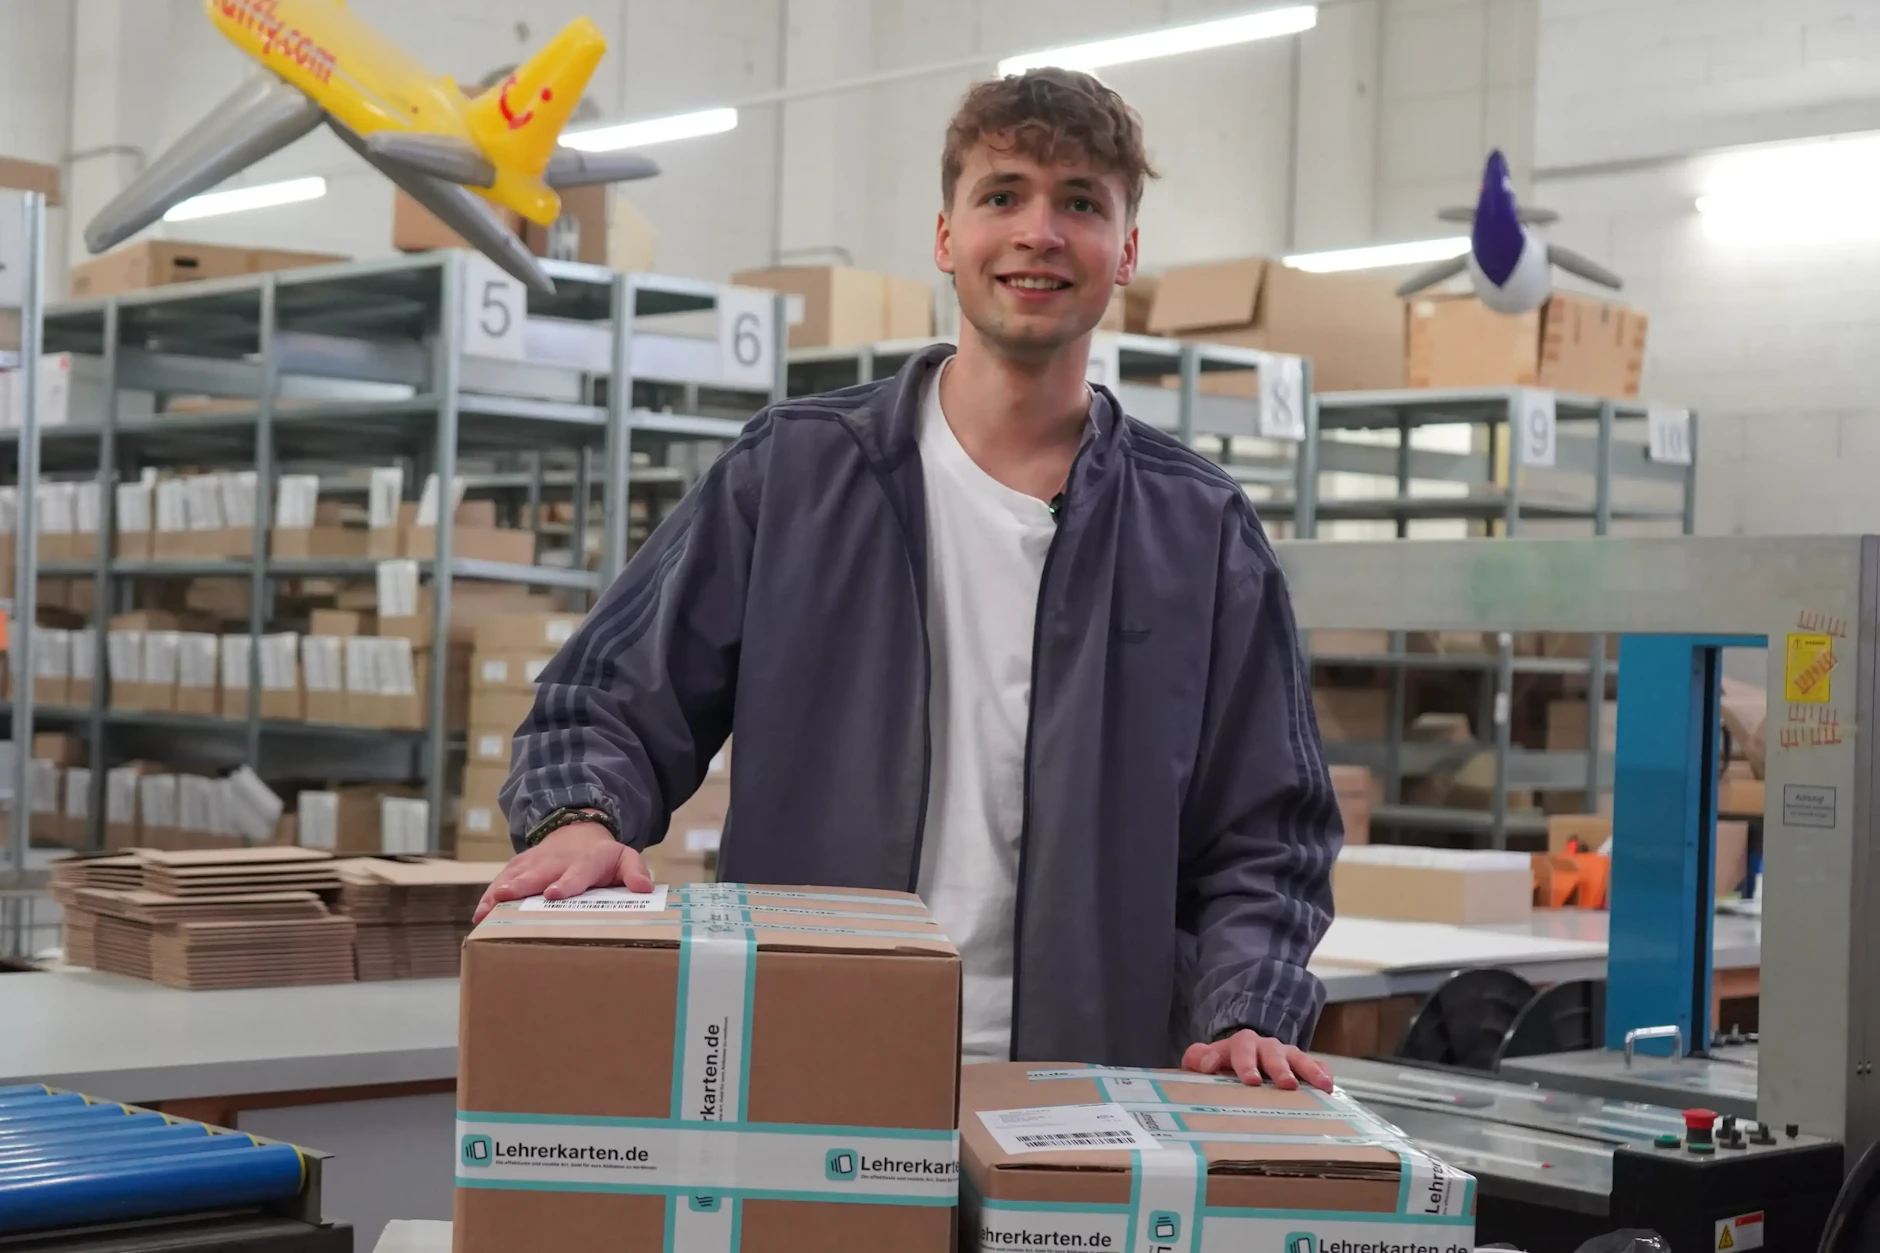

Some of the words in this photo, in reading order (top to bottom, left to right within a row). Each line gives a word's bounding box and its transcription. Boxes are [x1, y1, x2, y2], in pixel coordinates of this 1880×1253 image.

[481, 280, 511, 339] 5
[733, 312, 761, 367] 6
[1271, 377, 1293, 428] 8
[1530, 408, 1549, 458] 9
[1658, 421, 1686, 456] 10
[700, 1024, 720, 1121] rkarten.de
[495, 1141, 649, 1162] Lehrerkarten.de
